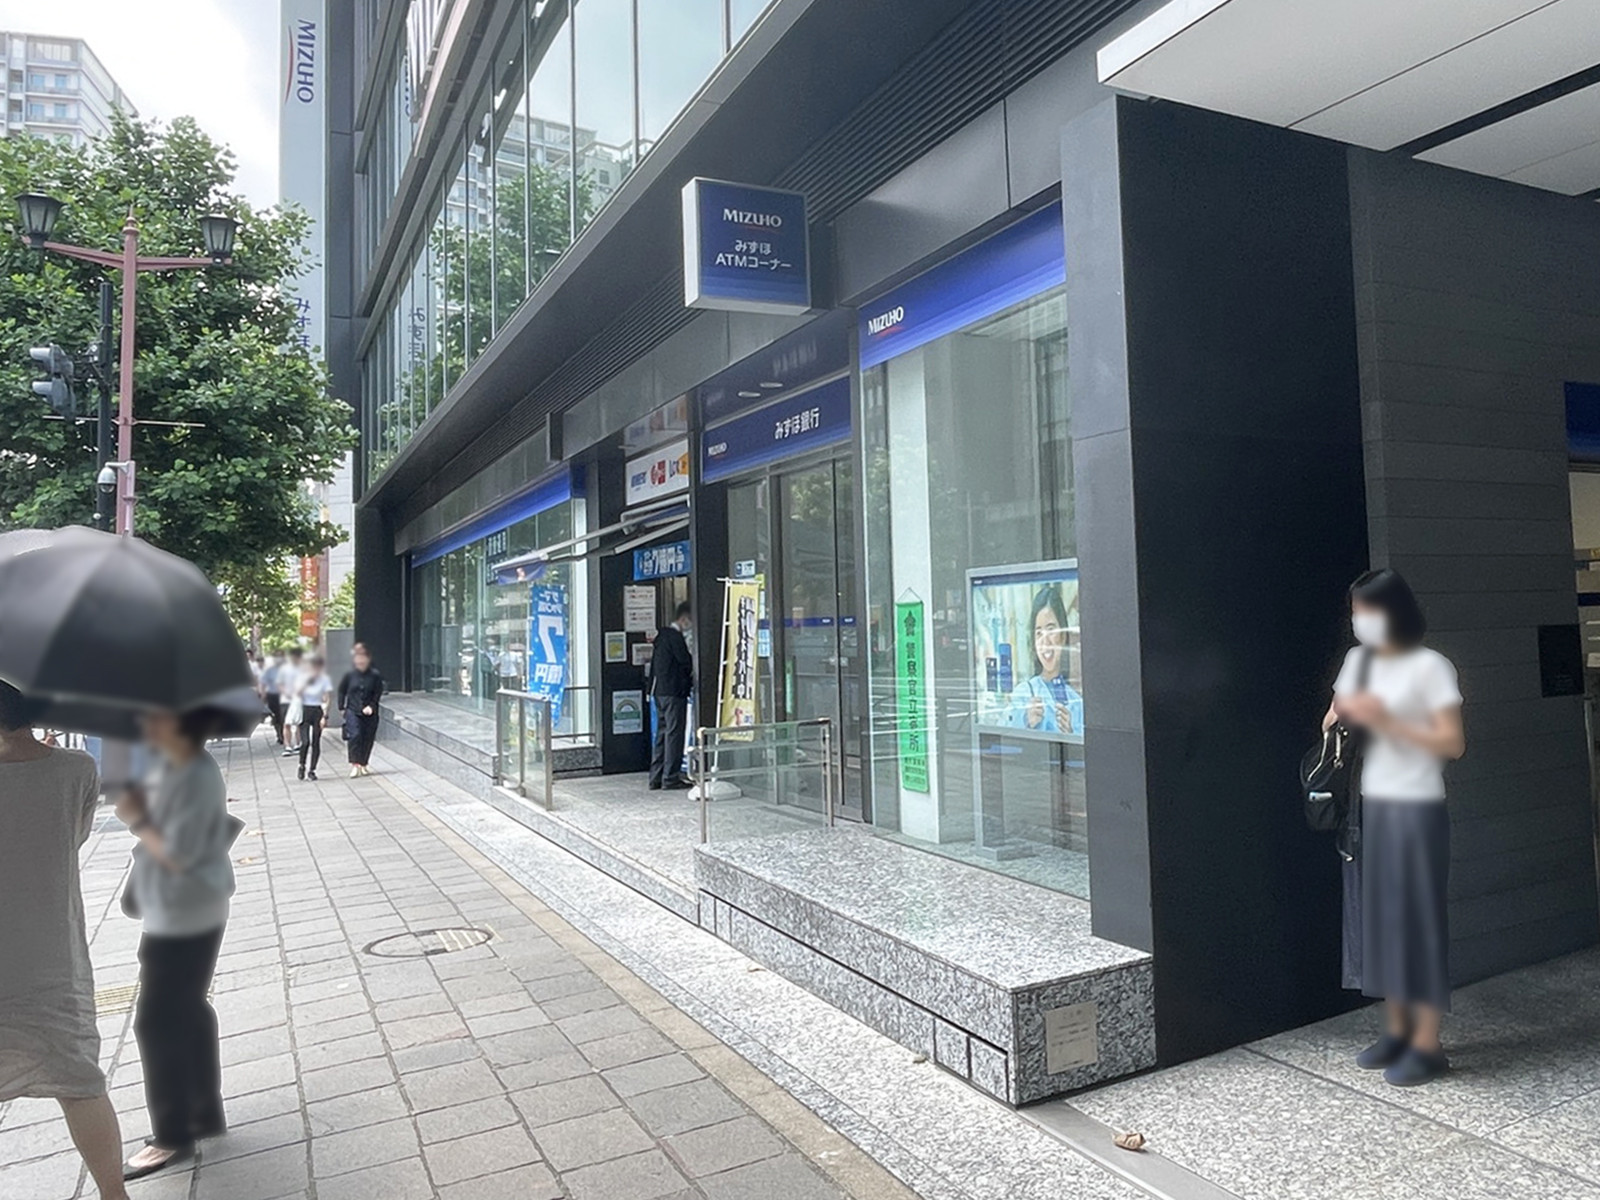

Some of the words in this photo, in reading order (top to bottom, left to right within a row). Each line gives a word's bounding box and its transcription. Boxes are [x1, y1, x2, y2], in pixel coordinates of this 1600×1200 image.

[297, 19, 316, 104] MIZUHO
[723, 208, 782, 228] MIZUHO
[735, 240, 771, 255] みずほ
[715, 254, 791, 270] ATMコーナー
[868, 306, 904, 335] MIZUHO
[776, 407, 820, 438] みずほ銀行
